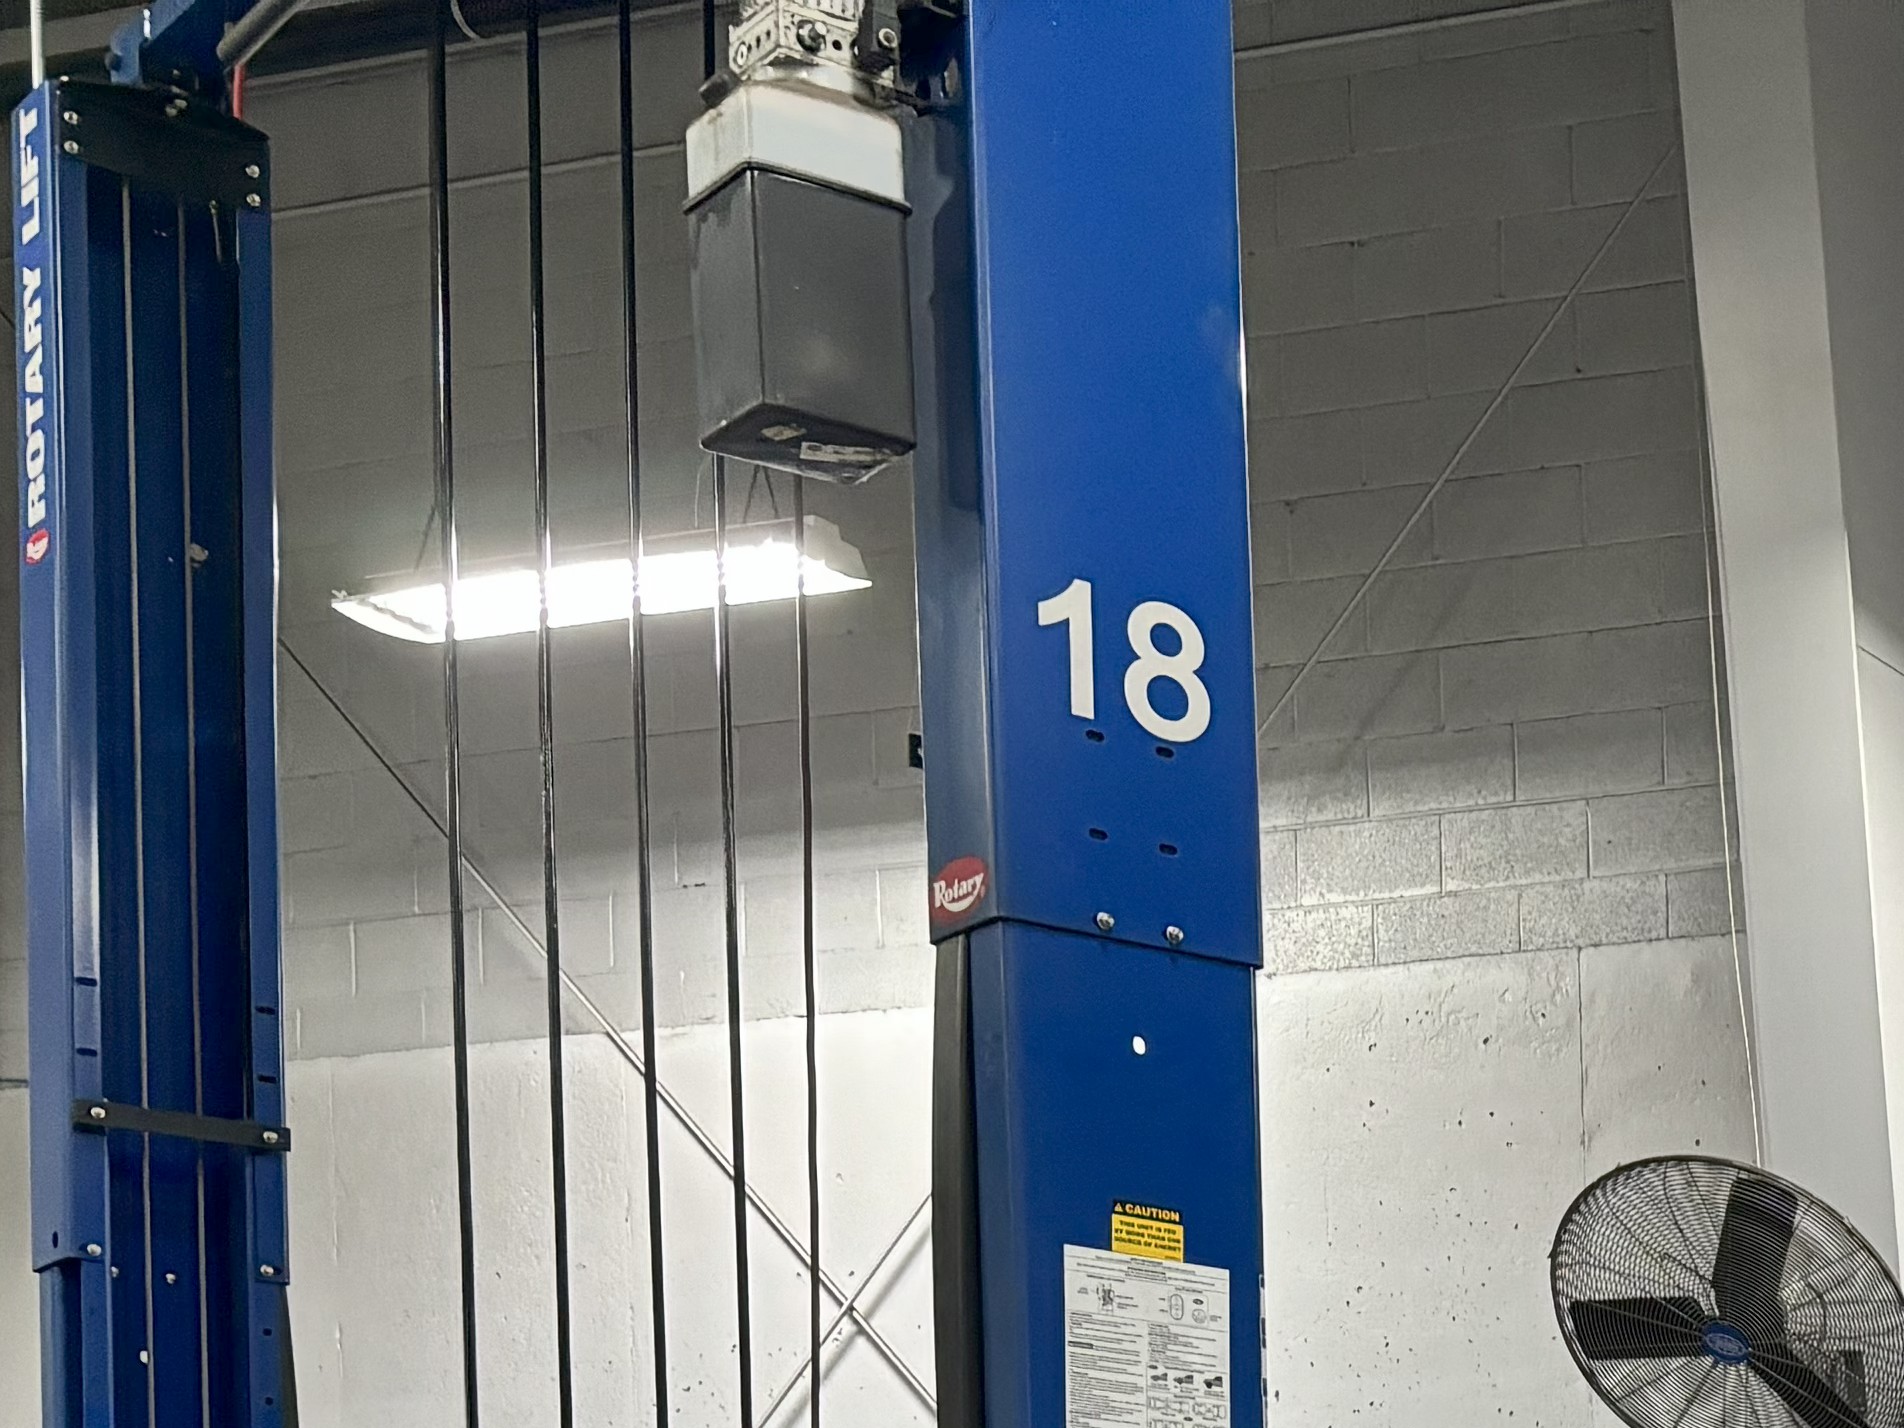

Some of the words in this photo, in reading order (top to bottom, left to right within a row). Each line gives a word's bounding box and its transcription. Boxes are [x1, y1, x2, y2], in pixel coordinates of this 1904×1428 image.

[18, 108, 40, 246] LIFT
[22, 267, 45, 528] ROTARY
[1037, 578, 1211, 743] 18
[933, 872, 984, 912] Rotary
[1125, 1203, 1180, 1222] CAUTION
